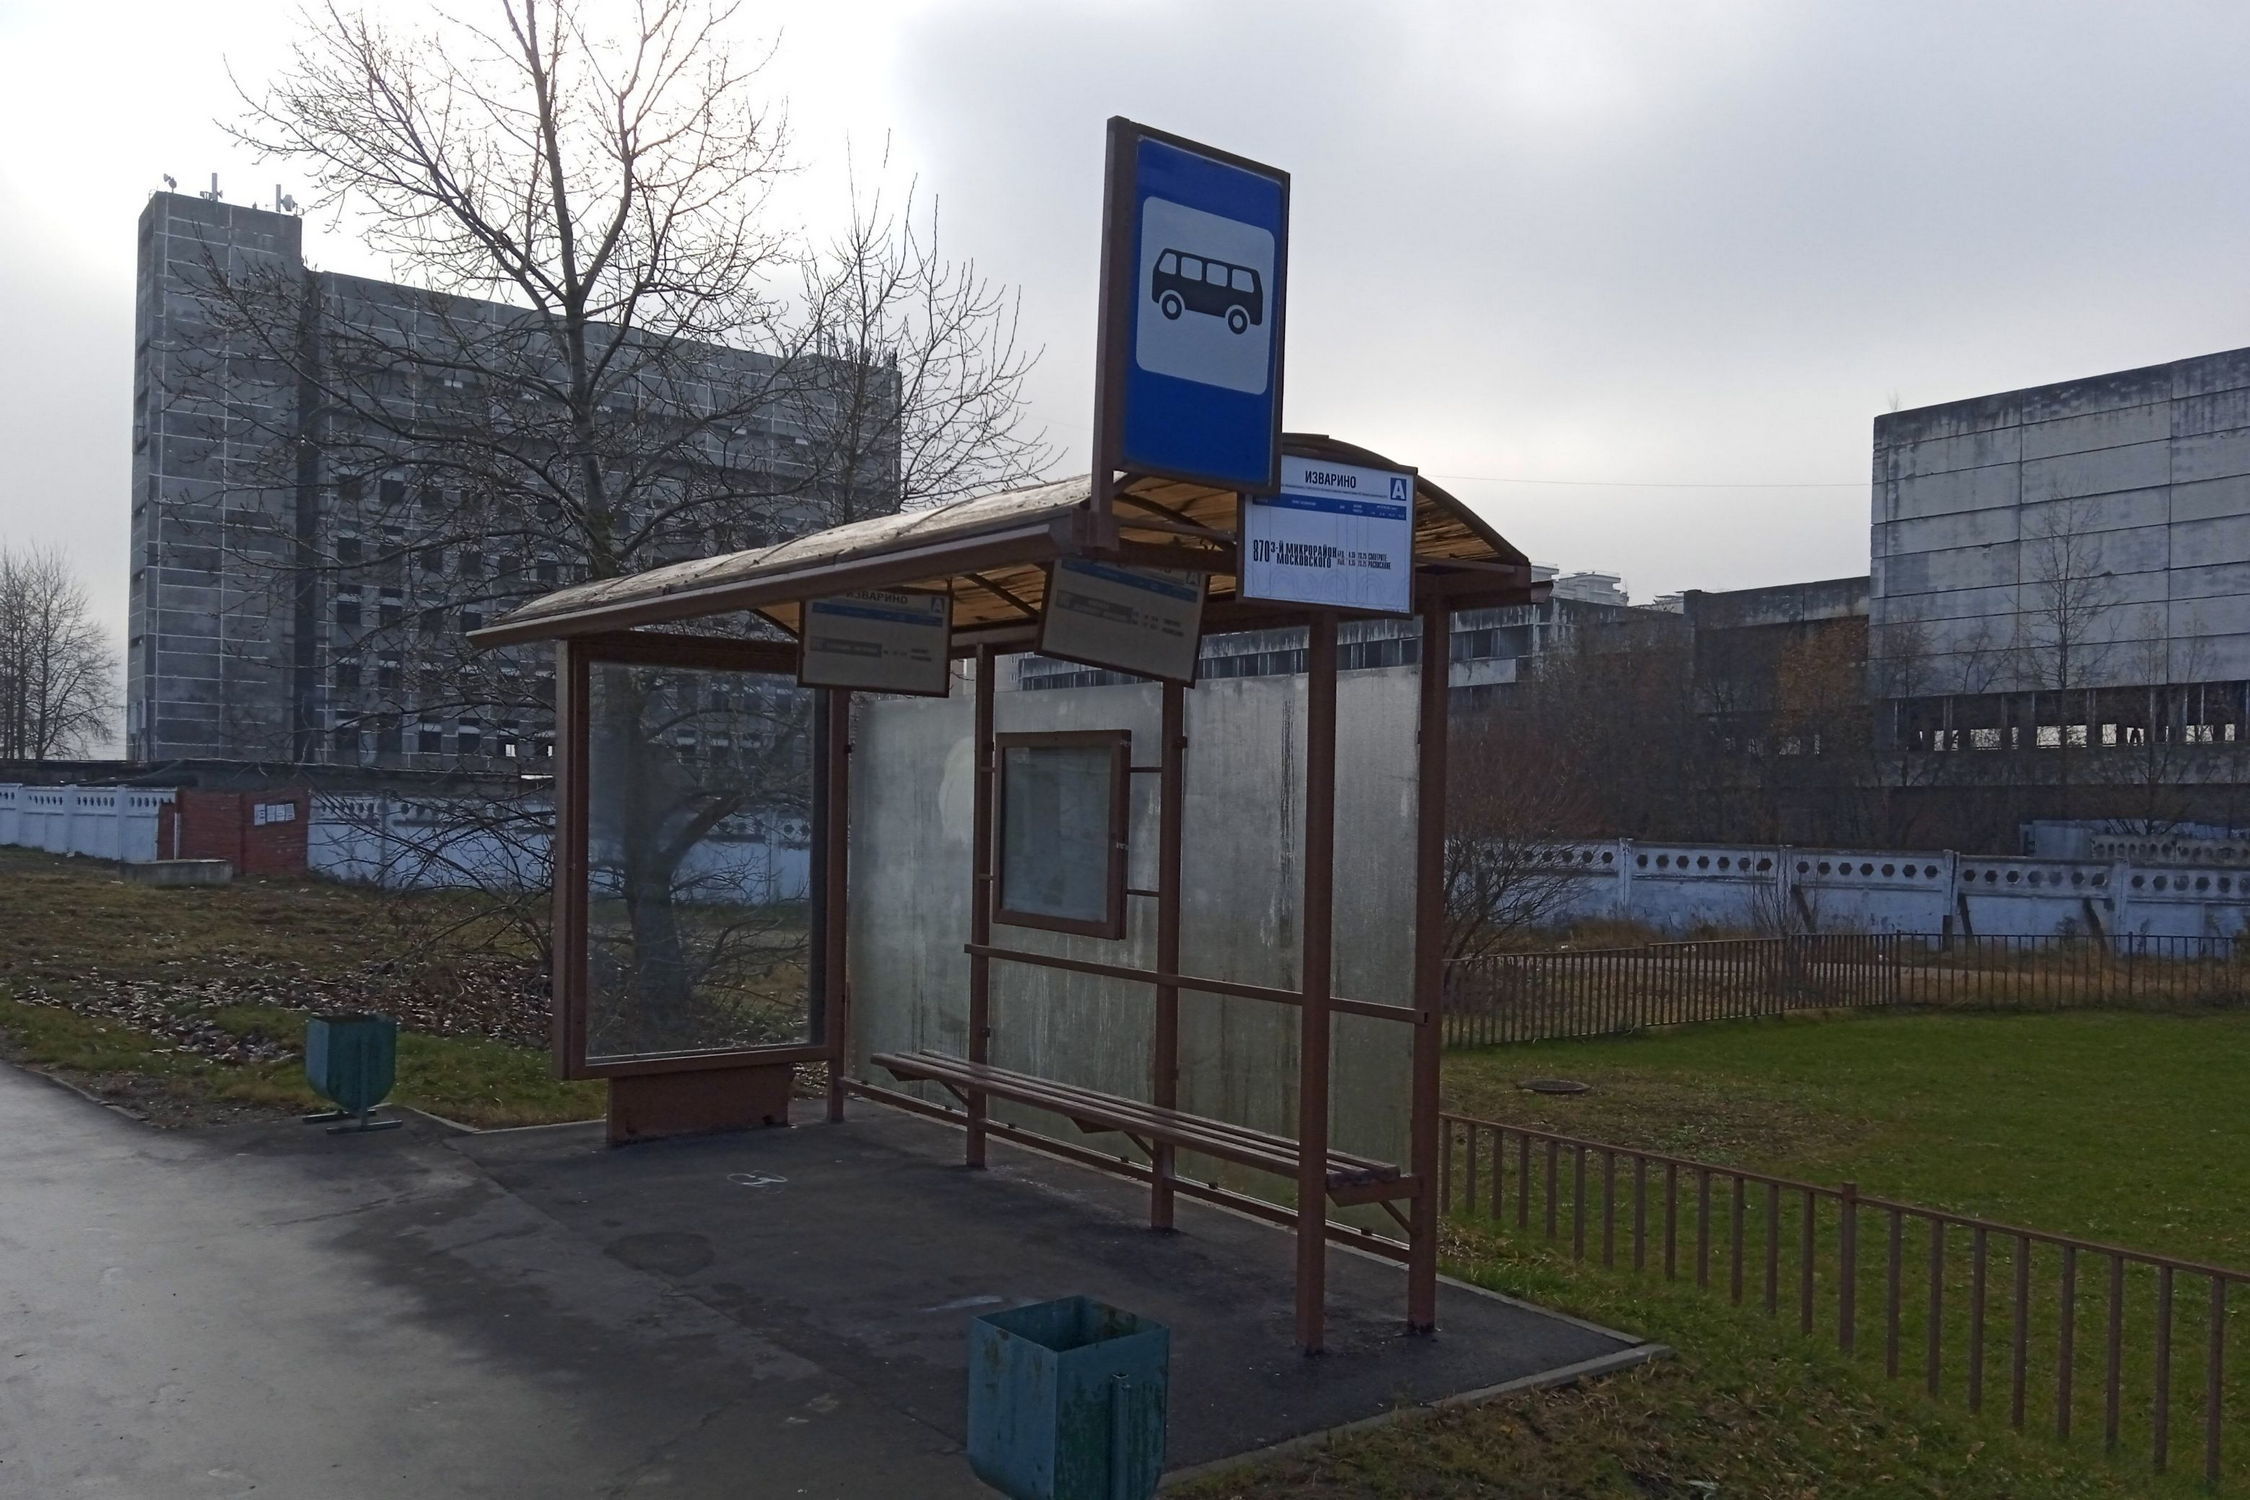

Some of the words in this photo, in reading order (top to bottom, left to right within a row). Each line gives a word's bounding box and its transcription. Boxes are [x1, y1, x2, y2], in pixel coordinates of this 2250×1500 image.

[1304, 470, 1357, 489] ИЗВАРИНО
[1253, 539, 1270, 563] 870
[1270, 540, 1284, 554] 3-Й
[1285, 542, 1337, 559] МИКРОРАЙОН
[1277, 553, 1332, 568] МОСКОВСКОГО
